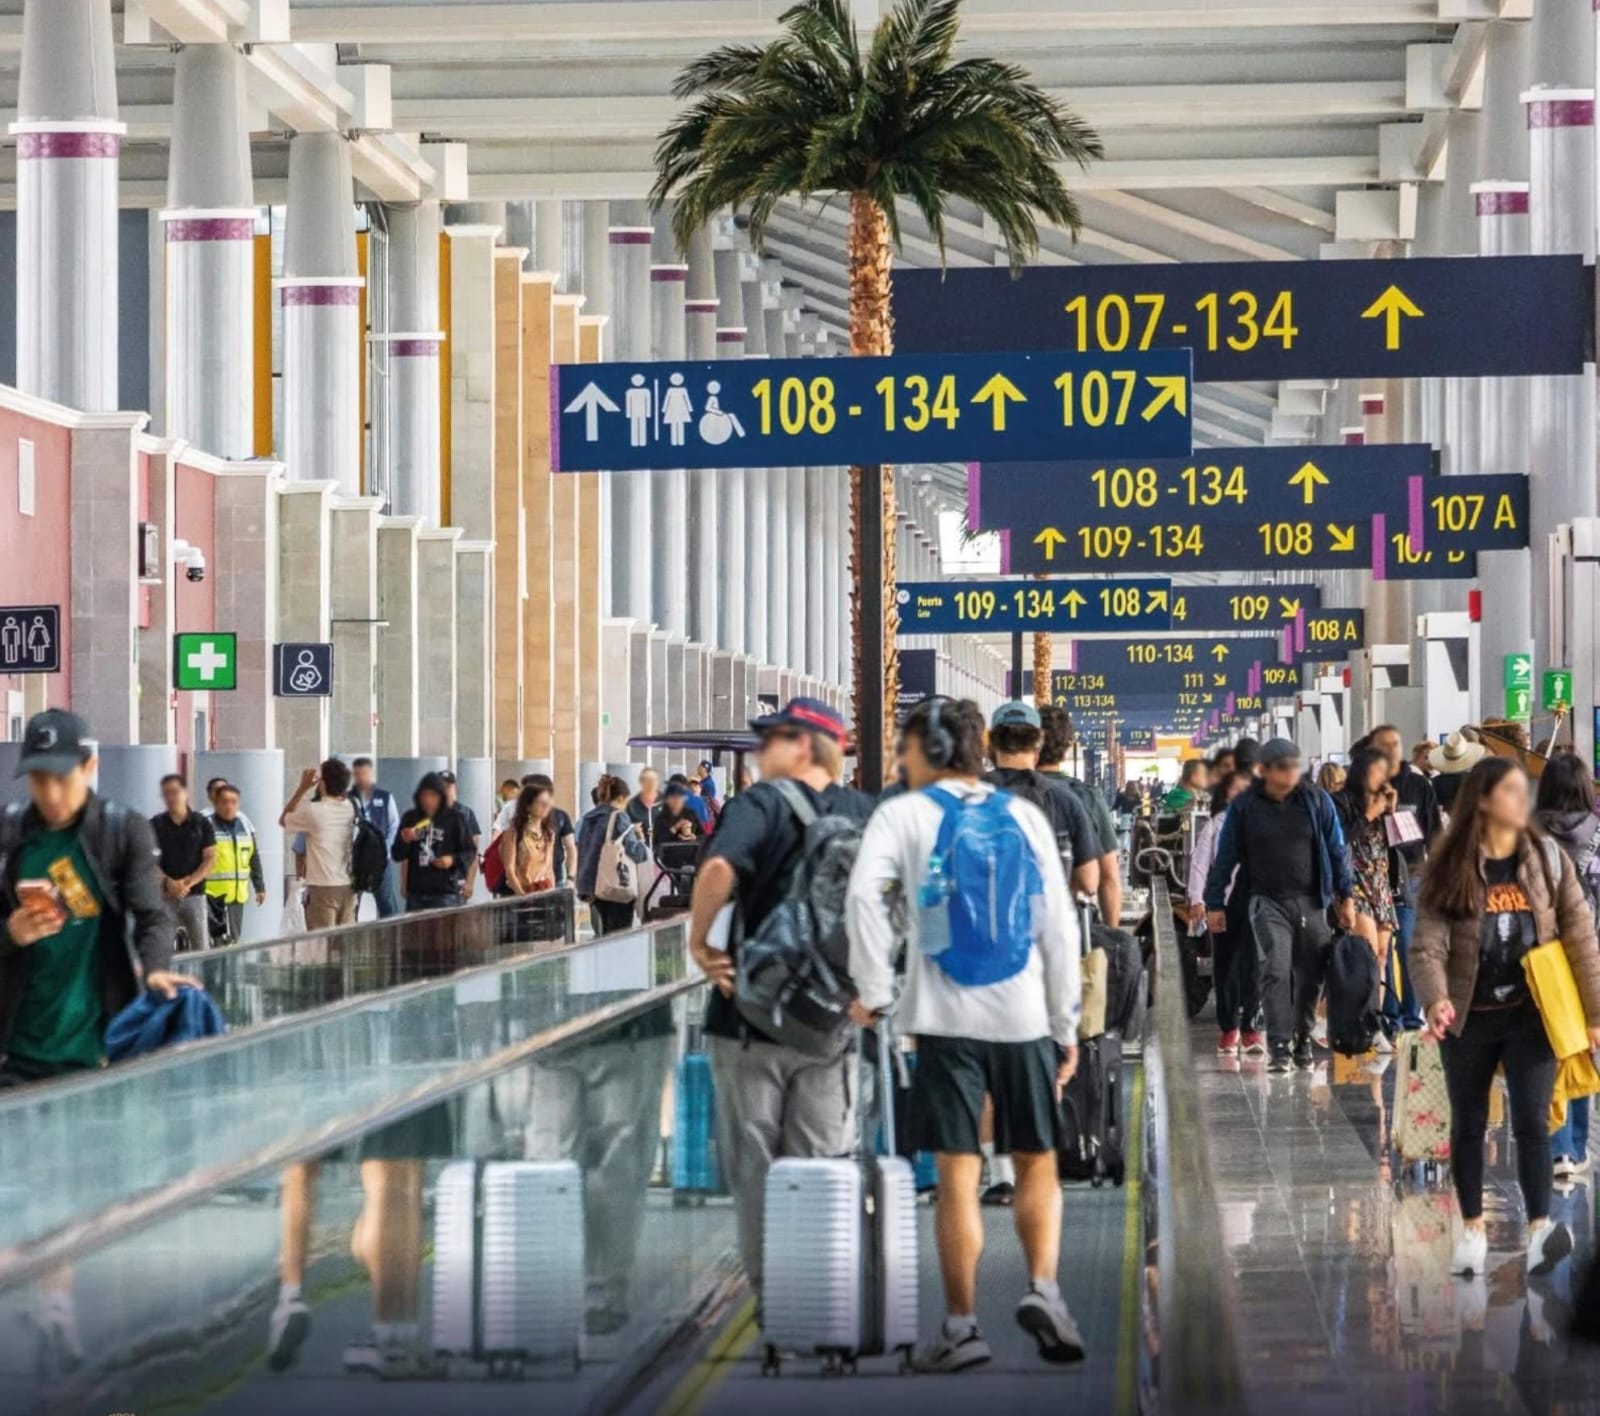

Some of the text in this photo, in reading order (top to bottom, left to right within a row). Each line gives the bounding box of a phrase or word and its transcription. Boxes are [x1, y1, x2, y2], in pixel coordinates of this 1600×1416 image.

[752, 376, 836, 435] 108
[875, 375, 960, 432] 134
[1054, 370, 1137, 427] 107
[1431, 494, 1516, 531] 107 A
[1258, 521, 1313, 556] 108
[954, 591, 995, 620] 109
[1014, 589, 1055, 618] 134
[1100, 588, 1141, 617] 108
[1229, 595, 1270, 621] 109
[1308, 619, 1357, 641] 108 A
[1183, 673, 1203, 688] 111
[1263, 668, 1297, 683] 109 A
